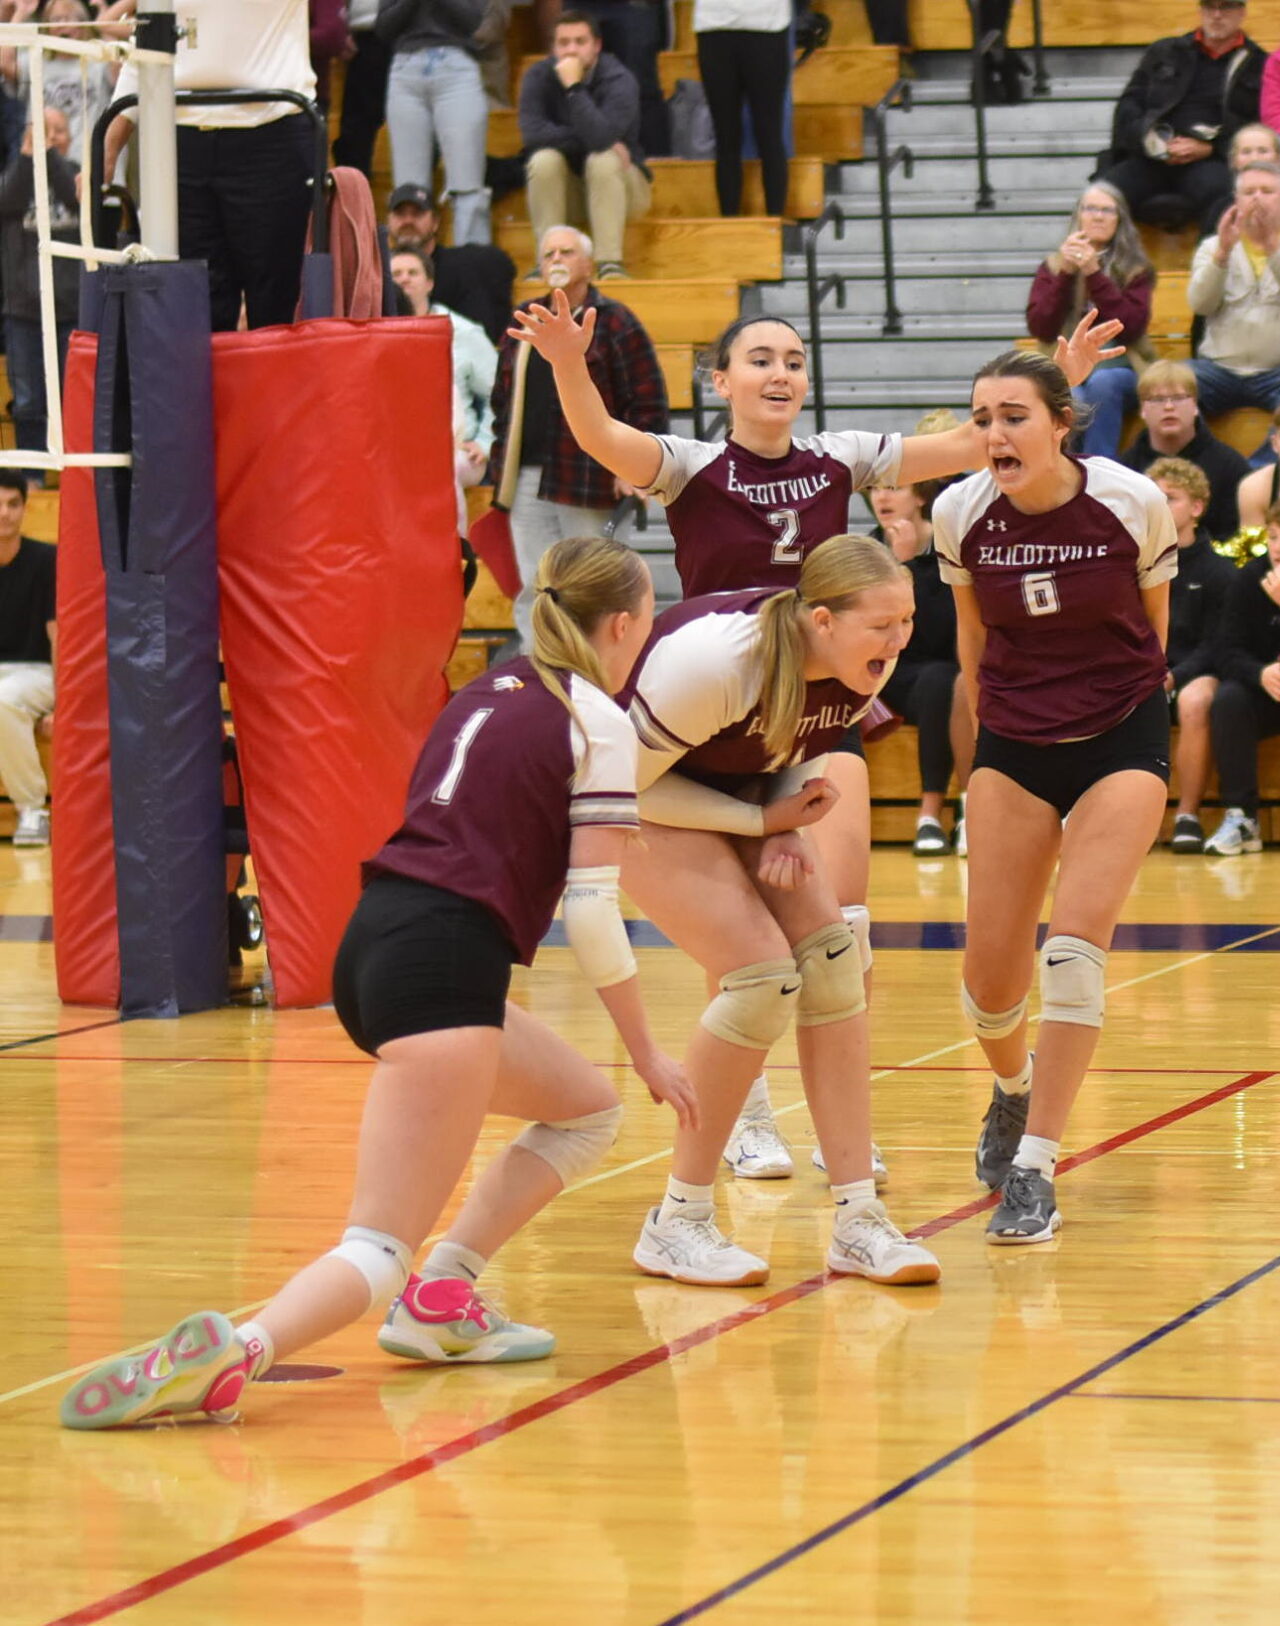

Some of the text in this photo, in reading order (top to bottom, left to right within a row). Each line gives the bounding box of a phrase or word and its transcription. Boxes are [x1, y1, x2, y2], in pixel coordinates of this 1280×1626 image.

[767, 508, 804, 564] 2
[1021, 571, 1060, 616] 6
[431, 708, 494, 805] 1
